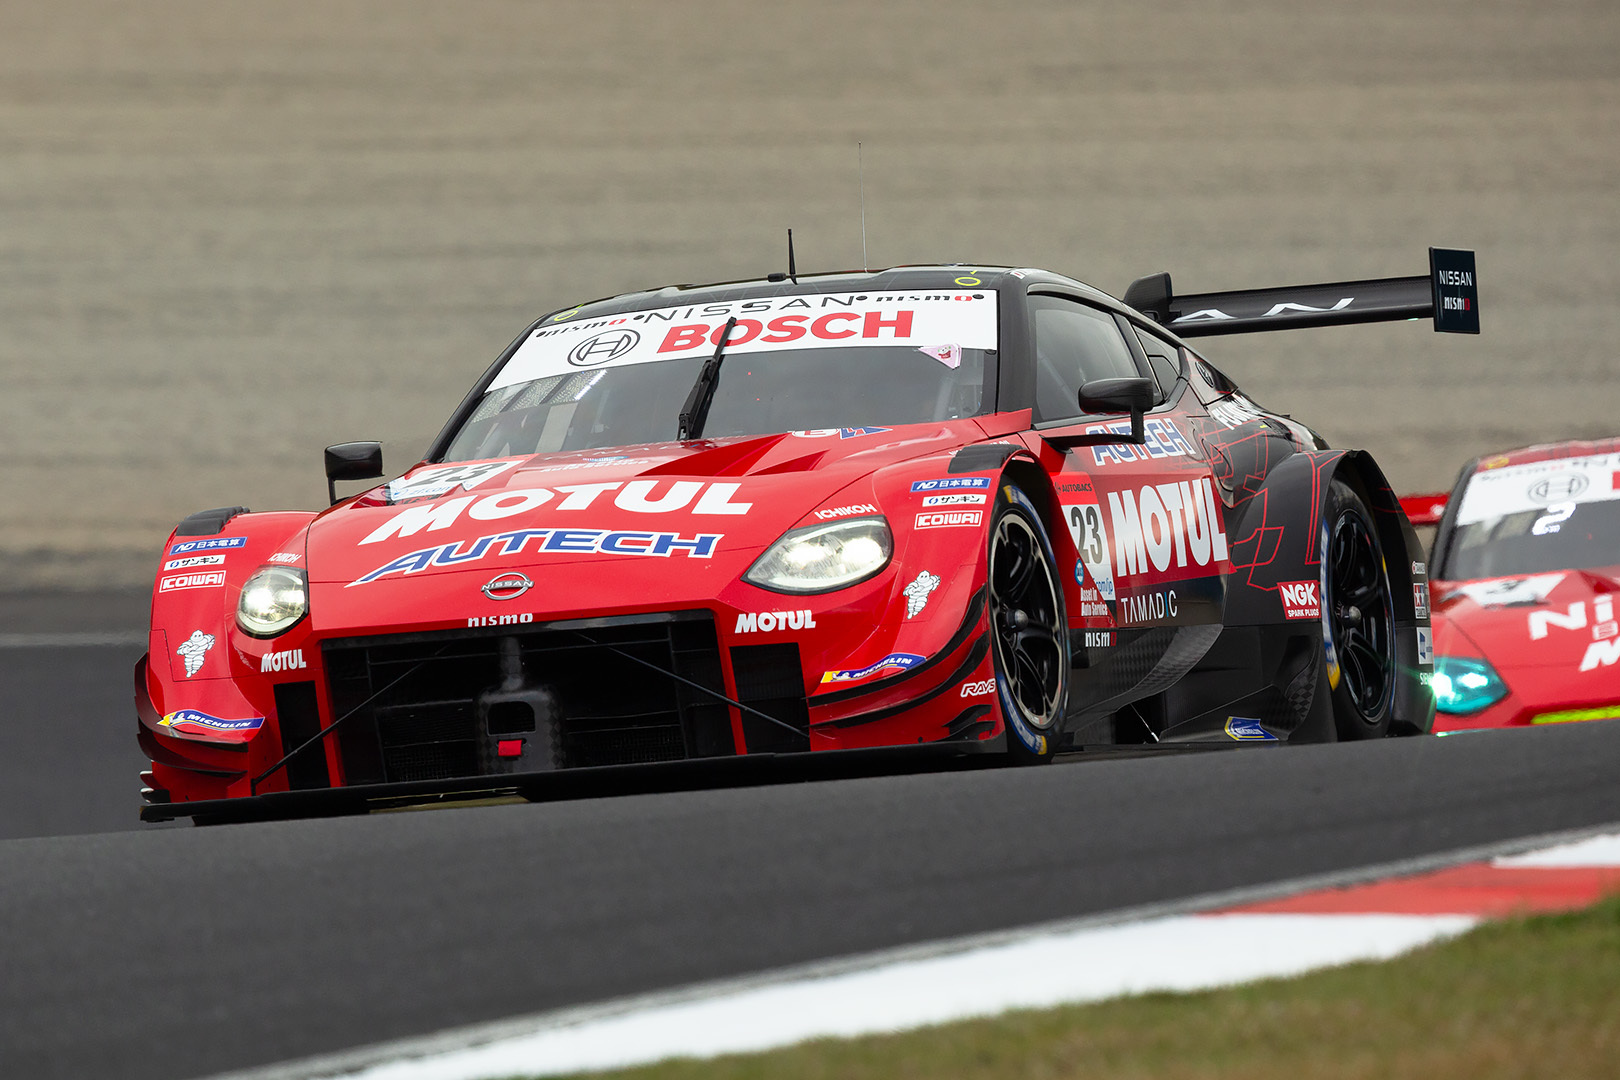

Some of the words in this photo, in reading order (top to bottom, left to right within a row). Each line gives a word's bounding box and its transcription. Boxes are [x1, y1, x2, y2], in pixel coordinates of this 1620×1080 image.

[1438, 270, 1473, 287] NISSAN
[876, 294, 973, 303] nismo
[1444, 296, 1470, 311] nismo
[643, 295, 855, 324] NISSAN
[544, 318, 627, 338] nismo
[656, 310, 915, 354] BOSCH
[1062, 483, 1093, 493] AUTOBACS
[940, 495, 981, 504] サンキン
[357, 480, 753, 545] MOTUL
[814, 503, 878, 520] ICHIKOH
[917, 513, 980, 527] KOIWAI
[1070, 505, 1103, 565] 23
[1107, 477, 1229, 578] MOTUL
[181, 556, 219, 567] サンキン
[345, 528, 725, 588] AUTECH
[162, 573, 223, 590] KOIWAI
[481, 580, 533, 592] NISSAN
[1281, 583, 1318, 607] NGK
[1121, 589, 1178, 624] TAMADIC
[1288, 609, 1305, 618] SPARK
[1305, 608, 1319, 617] PLUGS
[467, 613, 533, 628] nismo
[735, 610, 817, 634] MOTUL
[1085, 631, 1117, 648] nismo
[260, 649, 307, 673] MOTUL
[853, 657, 913, 678] MICHELIN
[960, 677, 996, 698] RAYS
[187, 713, 252, 728] MICHELIN
